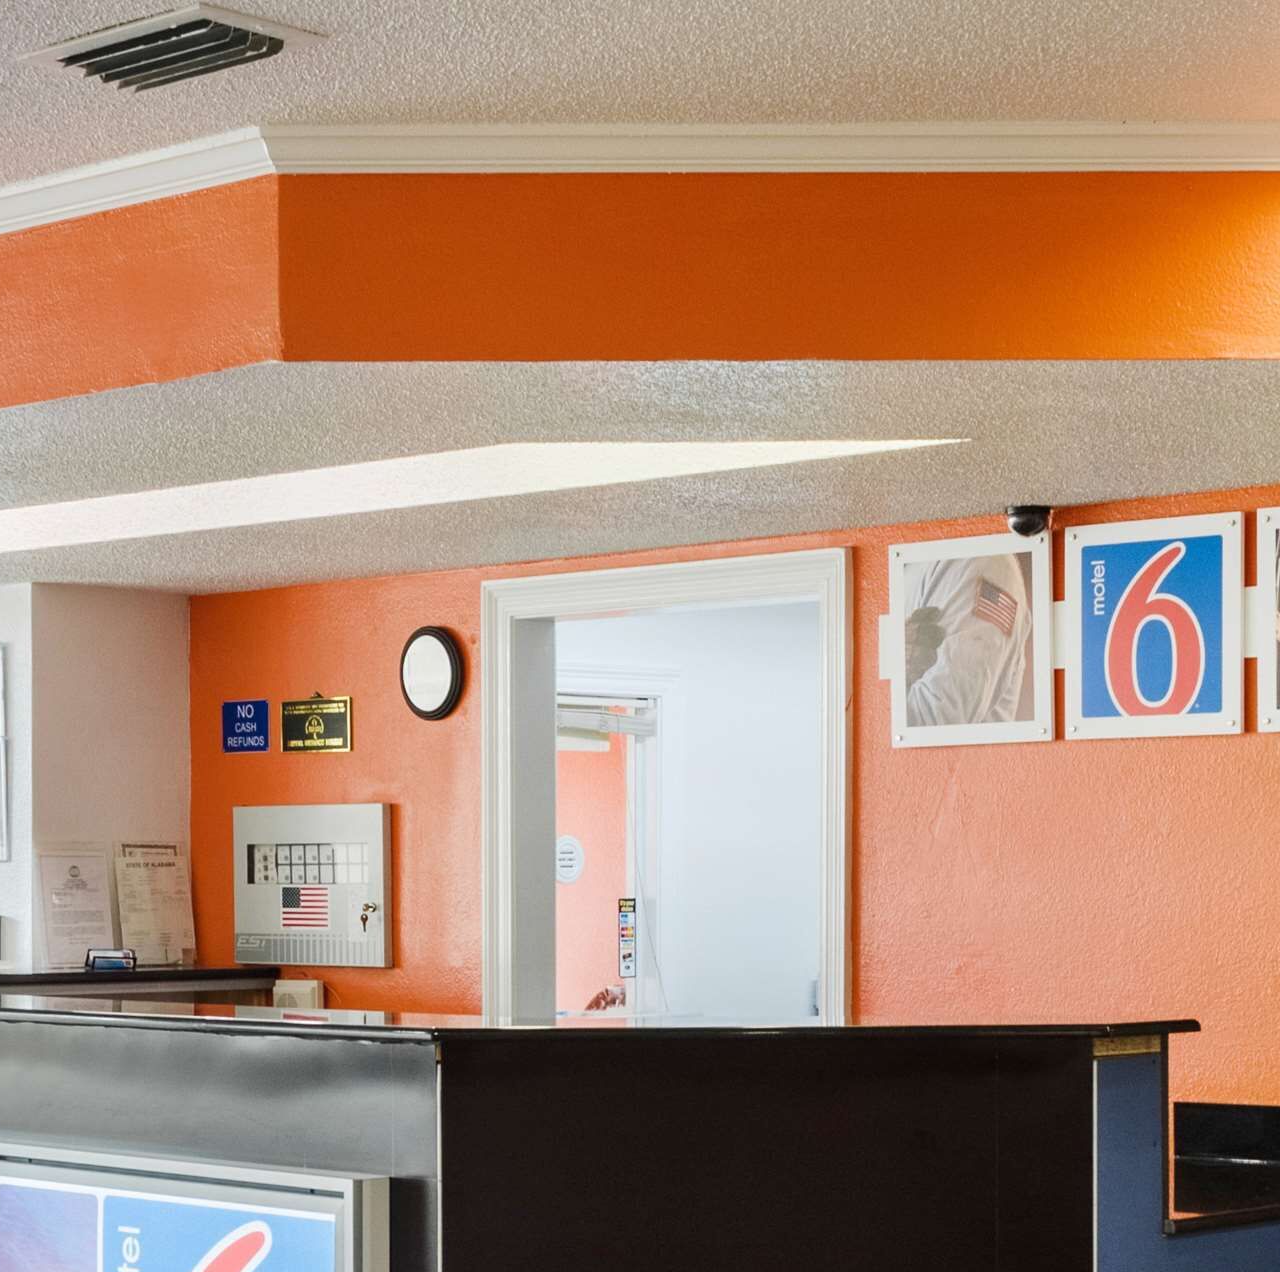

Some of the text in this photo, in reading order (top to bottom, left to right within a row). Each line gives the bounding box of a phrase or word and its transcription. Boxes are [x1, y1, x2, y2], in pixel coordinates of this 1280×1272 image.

[1091, 541, 1205, 717] motel 6
[236, 704, 254, 718] NO
[234, 722, 256, 733] CASH
[227, 736, 265, 747] REFUNDS
